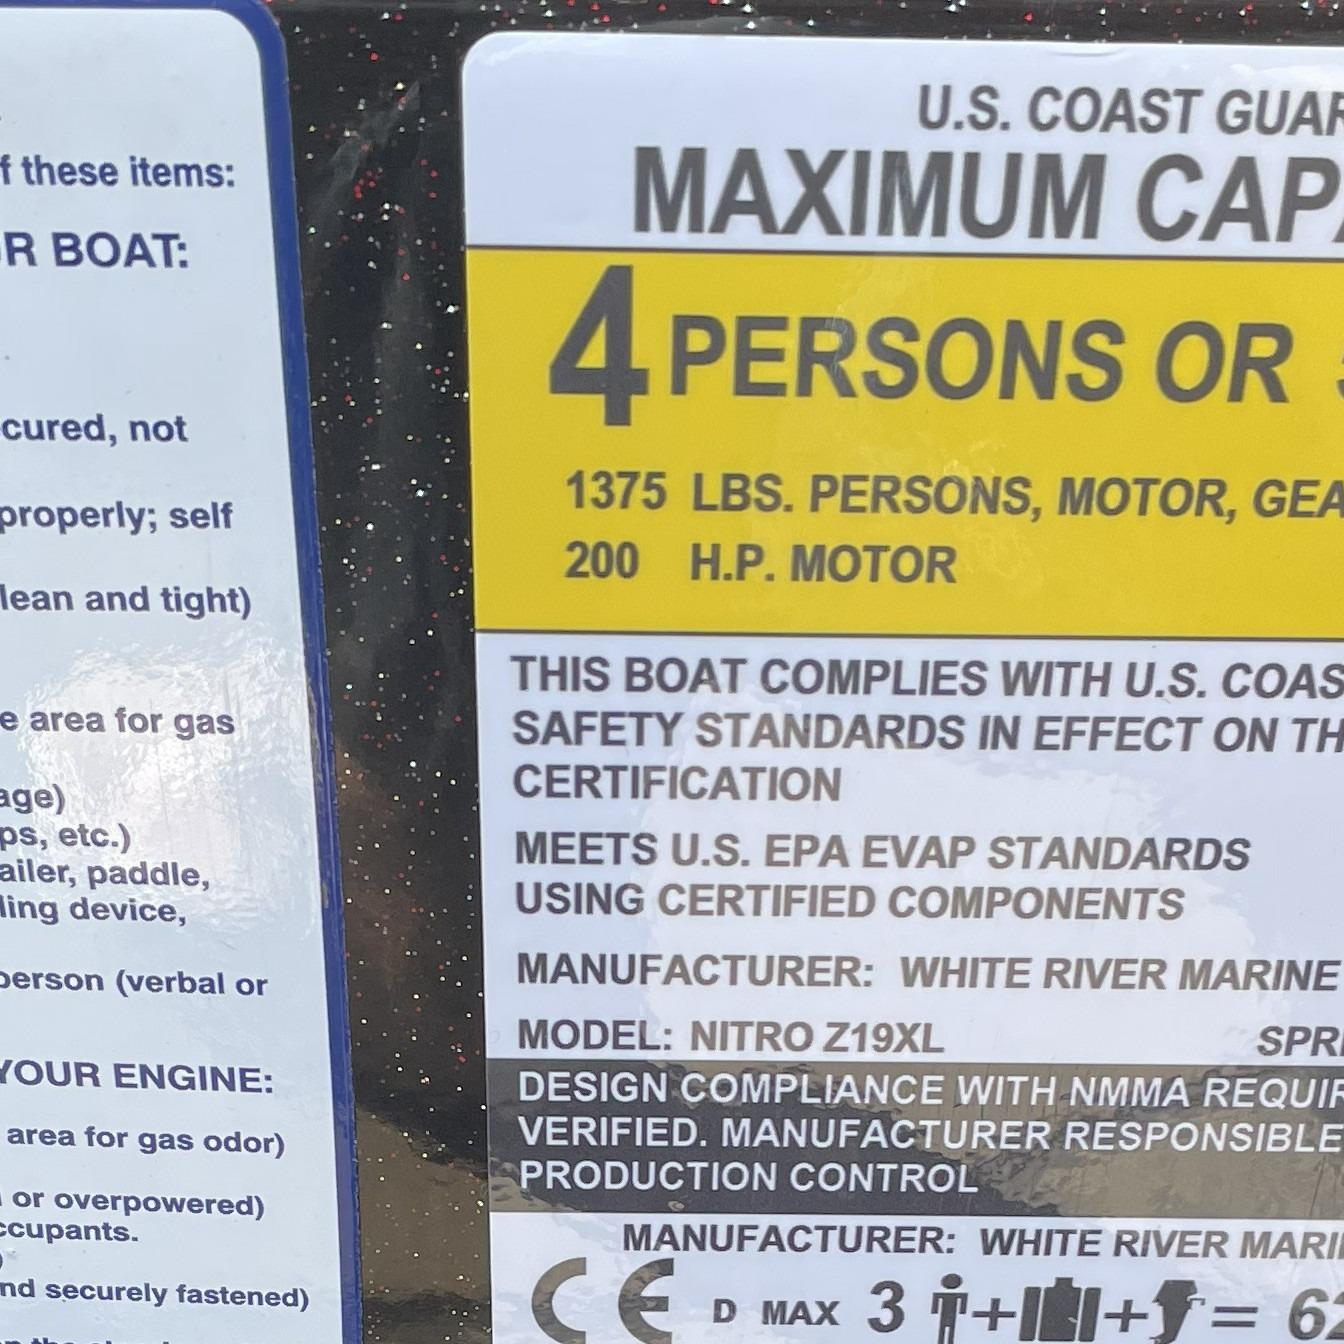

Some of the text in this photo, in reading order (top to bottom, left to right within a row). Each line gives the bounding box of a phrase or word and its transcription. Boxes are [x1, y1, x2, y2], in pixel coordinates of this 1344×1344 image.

[919, 84, 1010, 131] U.S.
[1028, 86, 1204, 134] COAST
[21, 155, 118, 186] these
[130, 156, 234, 187] items:
[634, 146, 1107, 239] MAXIMUM
[52, 232, 188, 268] BOAT:
[549, 264, 649, 426] 4
[671, 314, 1125, 402] PERSONS
[1156, 321, 1293, 403] OR
[170, 502, 233, 529] self
[567, 470, 667, 510] 1375
[693, 473, 793, 512] LBS.
[810, 474, 1041, 523] PERSONS,
[1058, 477, 1236, 525] MOTOR,
[565, 540, 957, 583] 200 H.P. MOTOR
[510, 655, 610, 692] THIS
[625, 657, 748, 693] BOAT
[760, 658, 988, 696] COMPLIES
[1001, 661, 1112, 697] WITH
[1126, 662, 1206, 698] U.S.
[30, 711, 105, 733] area
[114, 707, 163, 733] for
[174, 714, 235, 741] gas
[516, 831, 1251, 871] MEETS U.S. EPA EVAP STANDARDS
[87, 861, 209, 891] paddle,
[519, 1019, 945, 1053] MODEL: NITRO Z19XL
[113, 1063, 273, 1093] ENGINE:
[521, 1160, 978, 1192] PRODUCTION CONTROL
[713, 1298, 737, 1323] D
[762, 1300, 839, 1325] MAX
[868, 1280, 904, 1333] 3
